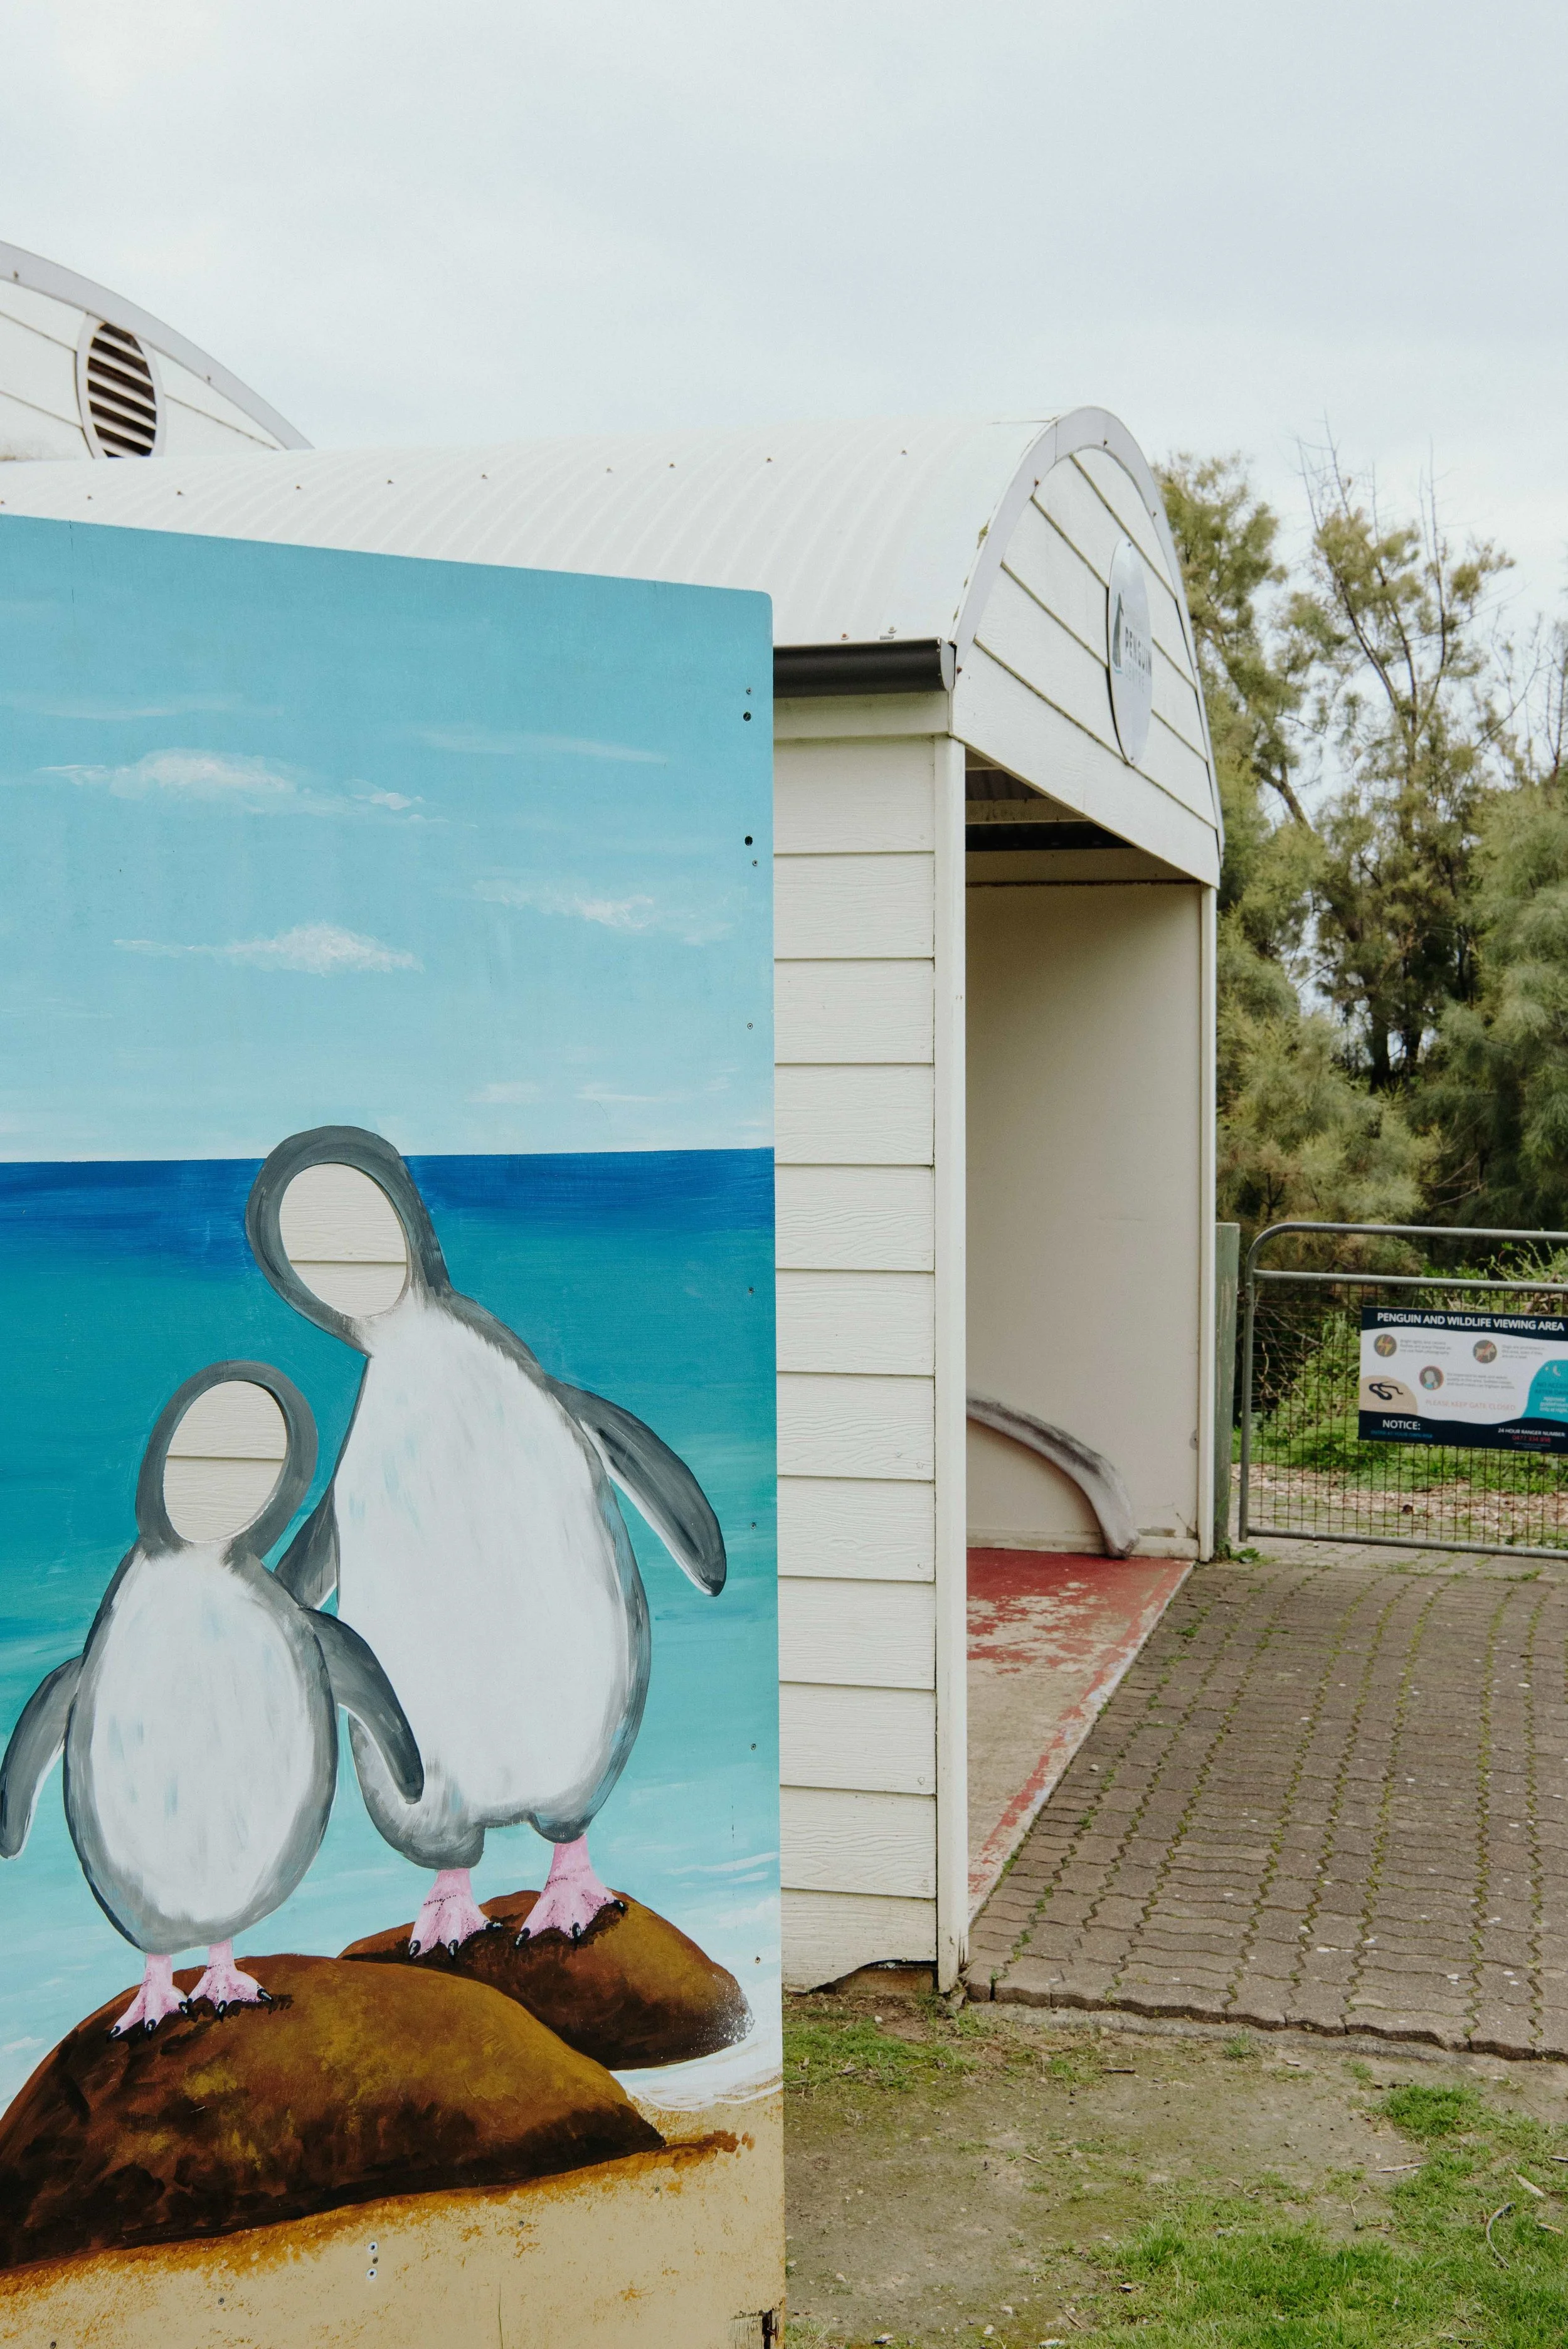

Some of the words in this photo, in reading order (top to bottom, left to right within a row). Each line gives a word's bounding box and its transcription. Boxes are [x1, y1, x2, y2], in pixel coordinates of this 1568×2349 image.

[1377, 1312, 1422, 1323] PENGUIN
[1422, 1315, 1446, 1325] AND
[1447, 1316, 1491, 1328] WILDLIFE
[1493, 1318, 1537, 1330] VIEWING
[1537, 1321, 1565, 1331] AREA
[1382, 1419, 1421, 1430] NOTICE:
